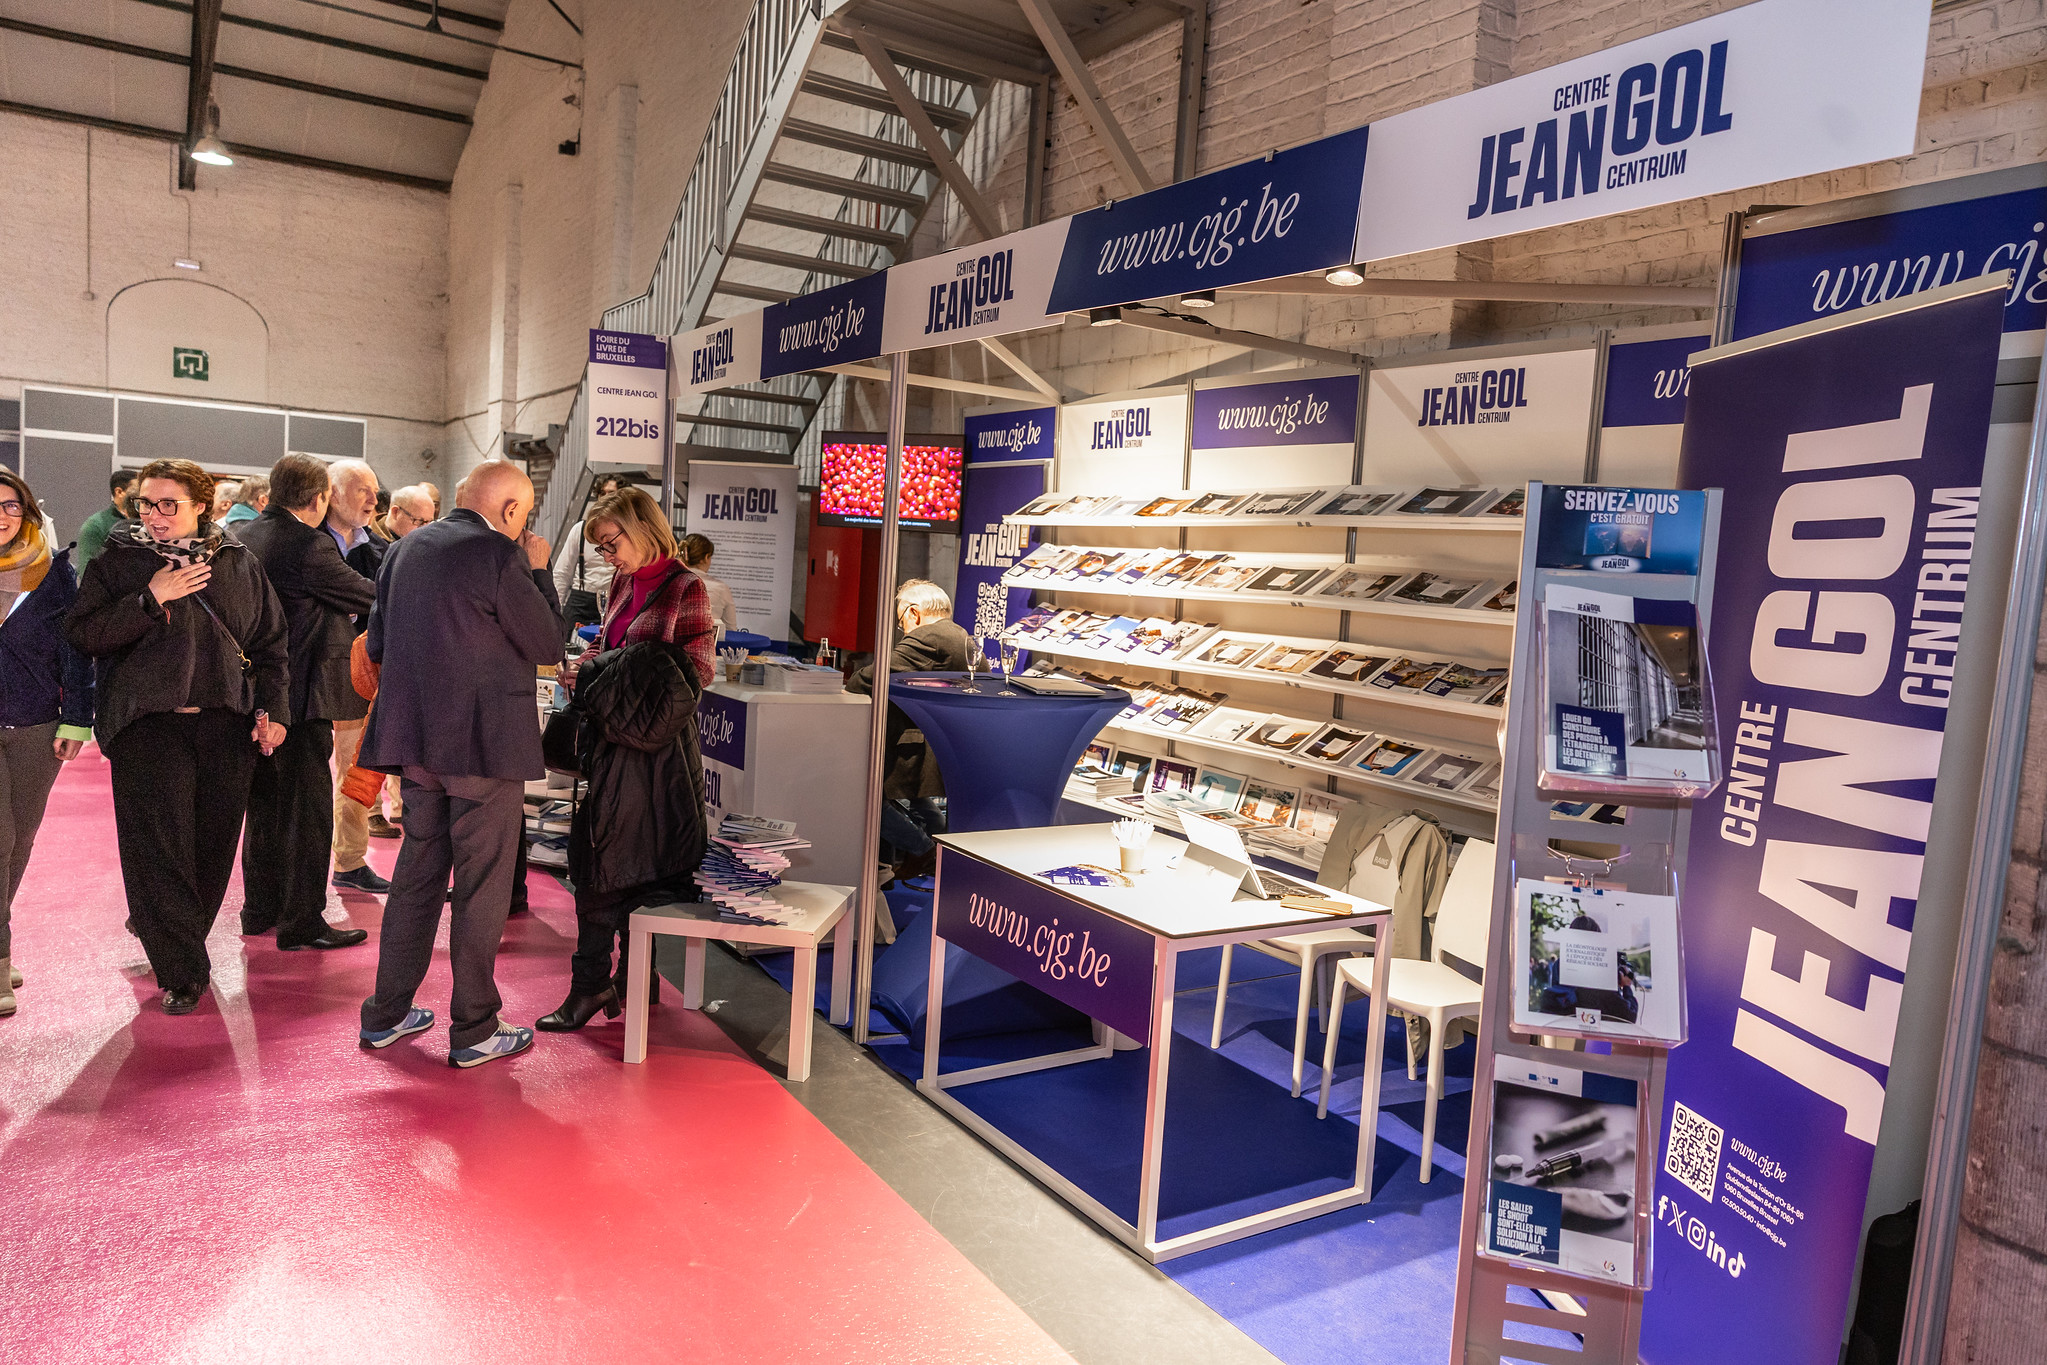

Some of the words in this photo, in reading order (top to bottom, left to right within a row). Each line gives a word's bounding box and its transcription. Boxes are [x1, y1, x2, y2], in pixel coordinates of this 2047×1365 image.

[1553, 73, 1611, 112] CENTRE
[1467, 104, 1608, 220] JEAN
[1611, 39, 1733, 157] GOL
[1606, 149, 1687, 190] CENTRUM
[1097, 181, 1300, 275] www.cjg.be
[956, 258, 976, 277] CENTRE
[924, 276, 974, 335] JEAN
[975, 249, 1014, 307] GOL
[779, 299, 865, 354] www.cjg.be
[973, 307, 1000, 326] CENTRUM
[596, 334, 618, 345] FOIRE
[618, 337, 630, 346] DU
[596, 343, 617, 354] LIVRE
[617, 346, 627, 354] DE
[596, 352, 636, 364] BRUXELLES
[690, 345, 715, 386] JEAN
[715, 327, 734, 367] GOL
[1455, 371, 1479, 384] CENTRE
[597, 387, 623, 396] CENTRE
[624, 389, 642, 398] JEAN
[642, 390, 658, 399] GOL
[1418, 385, 1479, 427] JEAN
[1479, 367, 1528, 410] GOL
[1111, 409, 1125, 418] CENTRE
[1218, 393, 1329, 435] www.cjg.be
[1478, 411, 1511, 424] CENTRUM
[596, 416, 659, 439] 212bis
[978, 420, 1041, 452] www.cjg.be
[1091, 420, 1124, 450] JEAN
[1125, 407, 1151, 438] GOL
[702, 494, 745, 521] JEAN
[746, 487, 779, 514] GOL
[1564, 490, 1679, 515] SERVEZ-VOUS
[1590, 513, 1613, 523] C'EST
[1615, 514, 1649, 525] GRATUIT
[965, 533, 997, 566] JEAN
[997, 524, 1021, 557] GOL
[1750, 382, 1934, 698] GOL
[1601, 560, 1617, 569] JEAN
[1617, 558, 1630, 567] GOL
[1577, 603, 1591, 612] JEAN
[1900, 486, 1982, 710] CENTRUM
[1562, 713, 1581, 724] LOUER
[1562, 721, 1601, 735] CONSTRUIRE
[1562, 730, 1574, 739] DES
[1575, 732, 1603, 744] PRISONS
[1563, 747, 1574, 757] LES
[1599, 745, 1617, 755] POUR
[1720, 700, 1777, 847] CENTRE
[704, 768, 721, 809] GOL
[1732, 707, 1945, 1147] JEAN
[969, 893, 1111, 988] www.cjg.be
[1730, 1137, 1788, 1183] www.cjg.be
[1727, 1162, 1746, 1180] Avenue
[1745, 1175, 1754, 1185] de
[1753, 1179, 1758, 1188] la
[1758, 1183, 1775, 1200] Toison
[1775, 1196, 1787, 1208] d'Or
[1498, 1199, 1510, 1210] LES
[1510, 1201, 1533, 1215] SALLES
[1498, 1208, 1506, 1218] DE
[1507, 1210, 1529, 1222] SHOOT
[1724, 1182, 1737, 1196] 1060
[1736, 1190, 1760, 1213] Bruxelles
[1759, 1207, 1780, 1226] Brussel
[1497, 1217, 1533, 1234] SONT-ELLES
[1534, 1225, 1547, 1237] UNE
[1780, 1211, 1795, 1225] 1060
[1496, 1227, 1527, 1242] SOLUTION
[1534, 1235, 1542, 1245] LA
[1496, 1236, 1540, 1254] TOXICOMANIE
